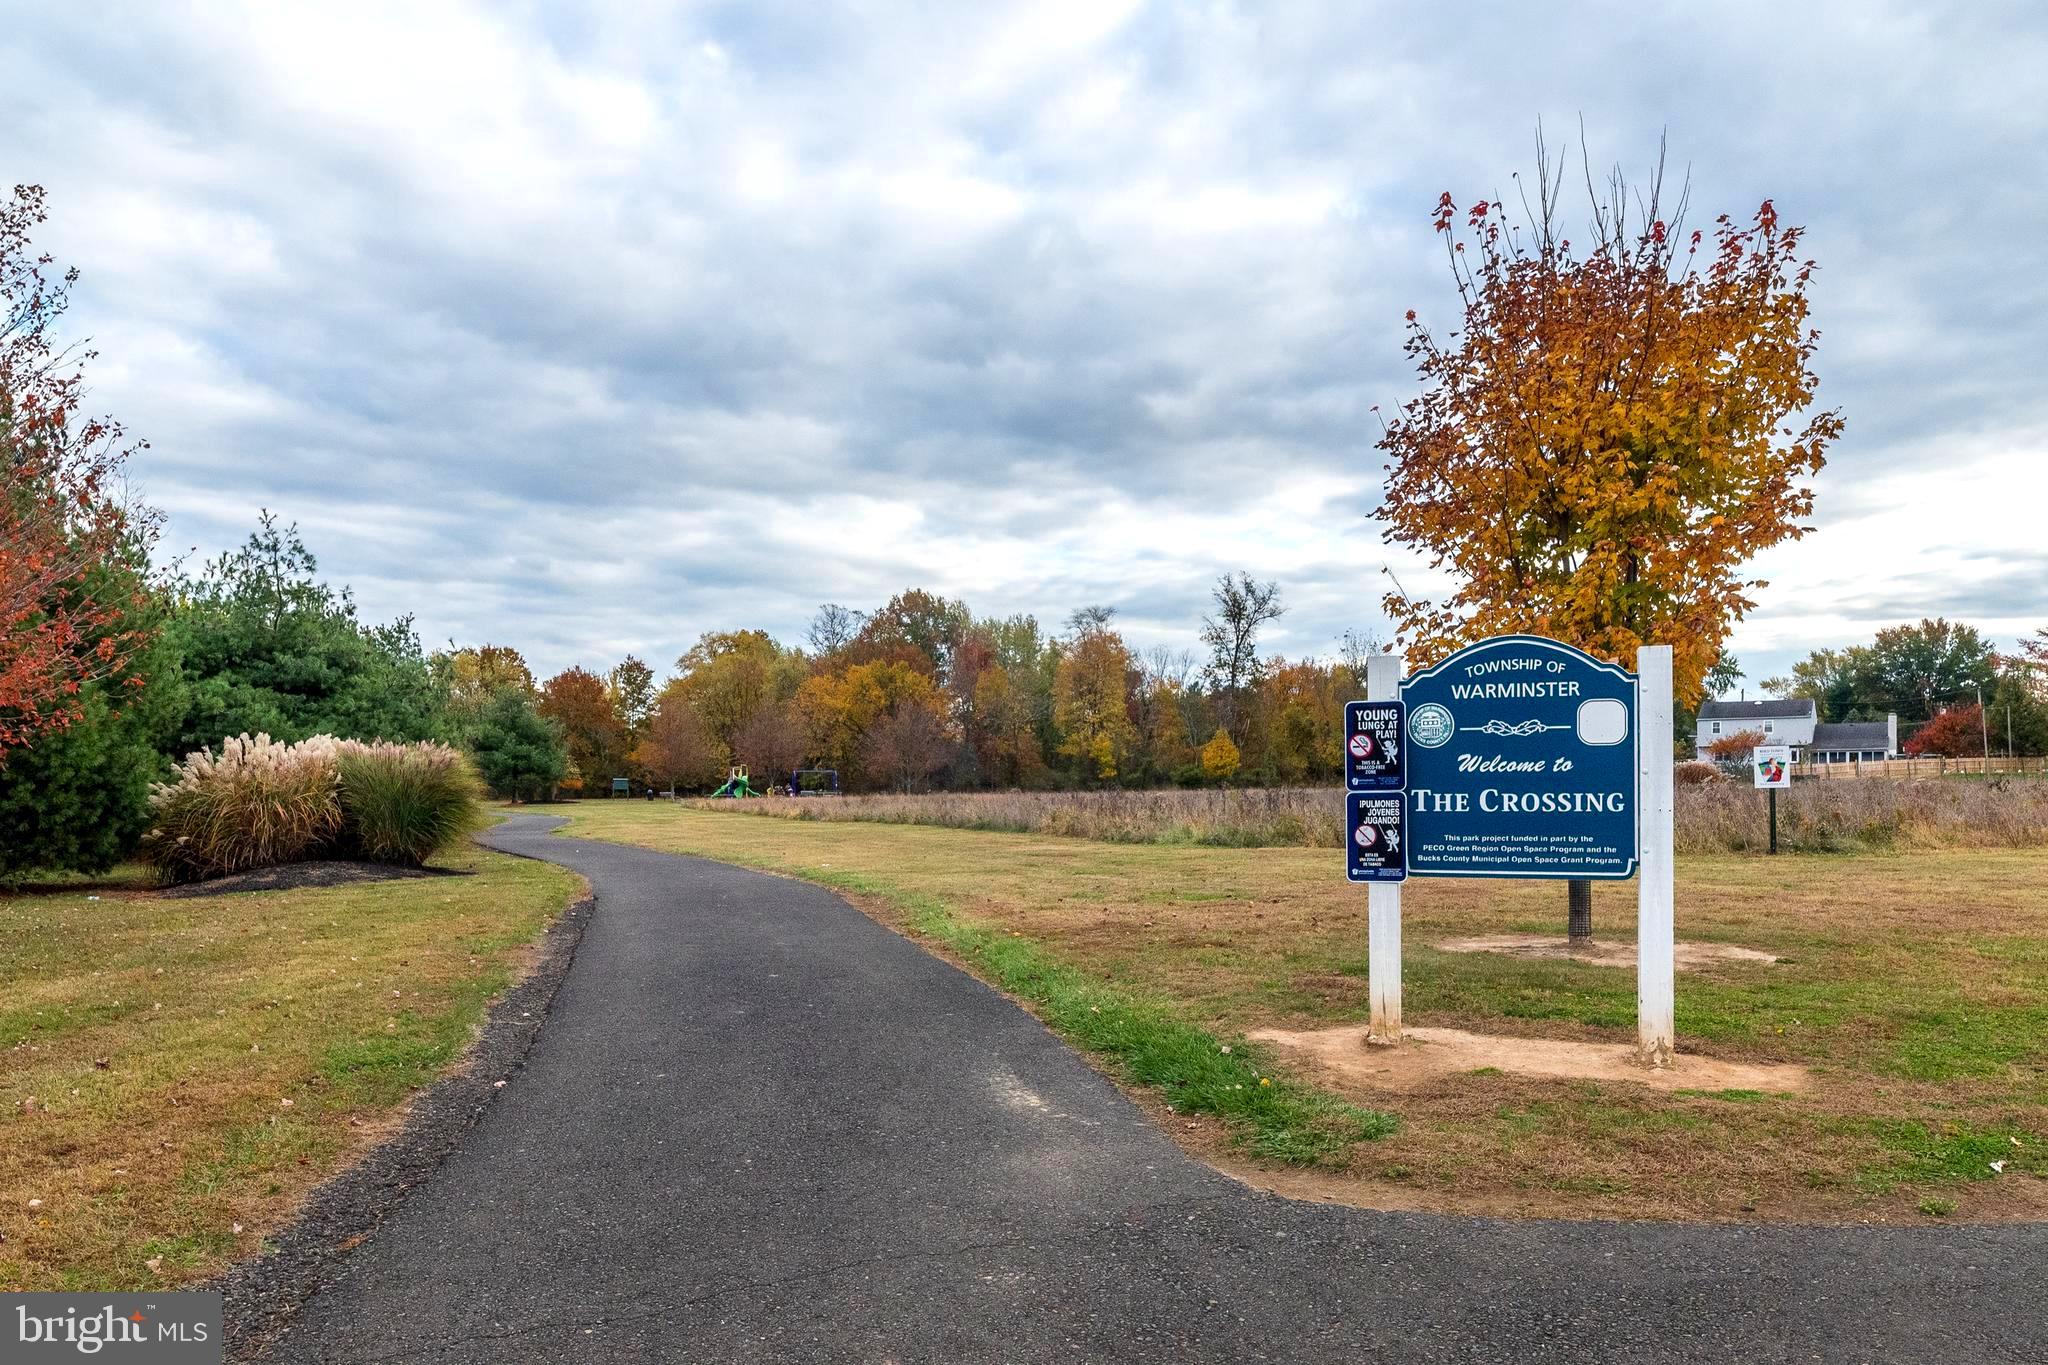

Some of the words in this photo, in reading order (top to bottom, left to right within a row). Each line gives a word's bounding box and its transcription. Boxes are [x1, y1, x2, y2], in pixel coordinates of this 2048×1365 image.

[1464, 658, 1542, 677] TOWNSHIP
[1546, 660, 1566, 674] OF
[1451, 681, 1580, 699] WARMINSTER
[1355, 709, 1398, 721] YOUNG
[1358, 721, 1385, 730] LUNGS
[1388, 720, 1398, 729] AT
[1375, 730, 1396, 738] PLAY!
[1457, 753, 1546, 772] Welcome
[1553, 756, 1574, 772] to
[1411, 789, 1470, 812] THE
[1479, 788, 1625, 812] CROSSING
[1481, 835, 1509, 843] project
[1500, 845, 1521, 853] Open
[1550, 846, 1584, 854] Program
[1443, 855, 1470, 863] County
[1511, 856, 1532, 864] Open
[1534, 856, 1559, 864] Space
[1585, 857, 1623, 865] Program.
